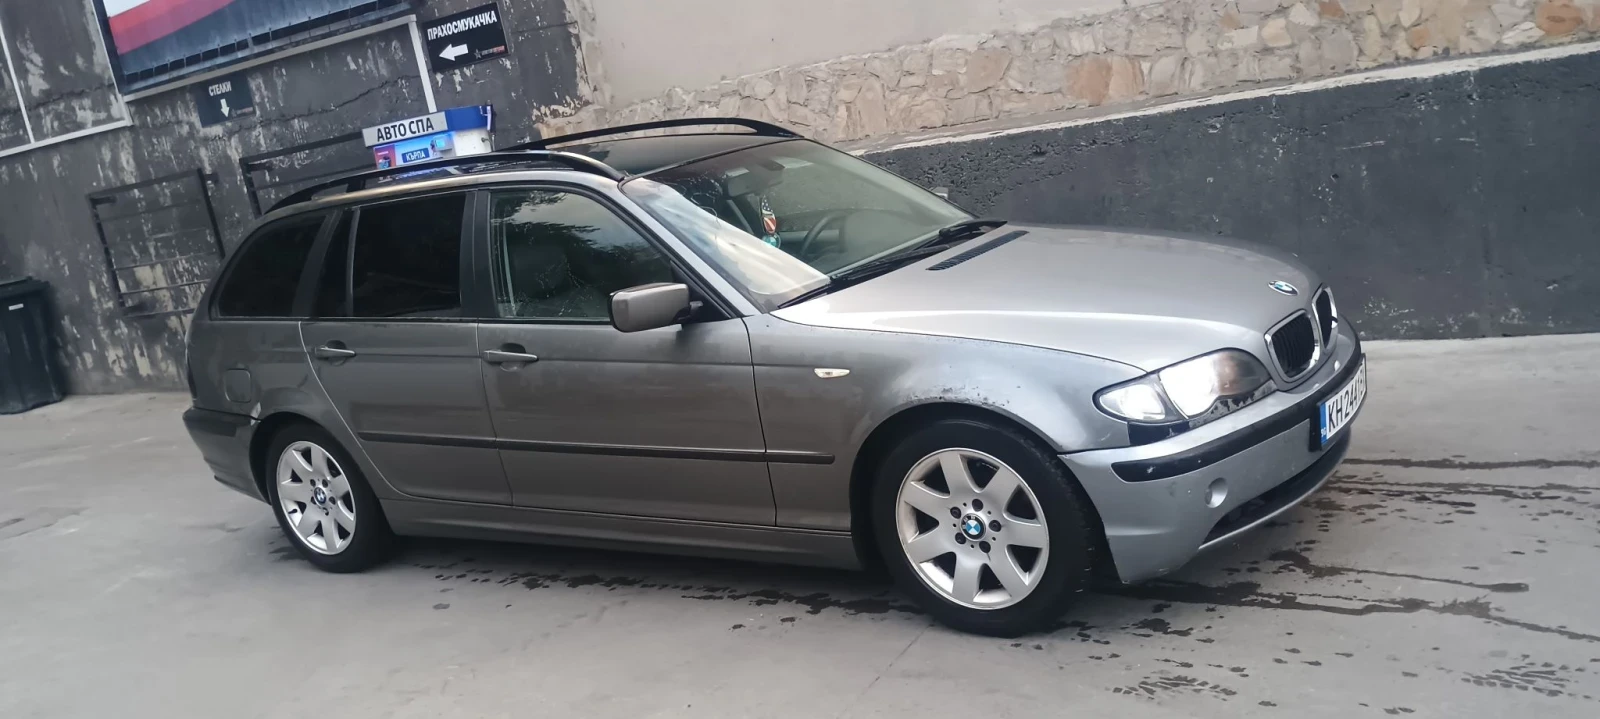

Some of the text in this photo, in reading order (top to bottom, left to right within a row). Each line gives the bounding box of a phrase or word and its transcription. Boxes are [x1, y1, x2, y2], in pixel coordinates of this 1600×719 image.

[427, 10, 498, 41] ПРАХОСМУКАЧКА
[208, 81, 232, 97] СТЕЛКИ
[377, 117, 435, 142] АВТО СПА
[405, 149, 426, 162] КЪРПА
